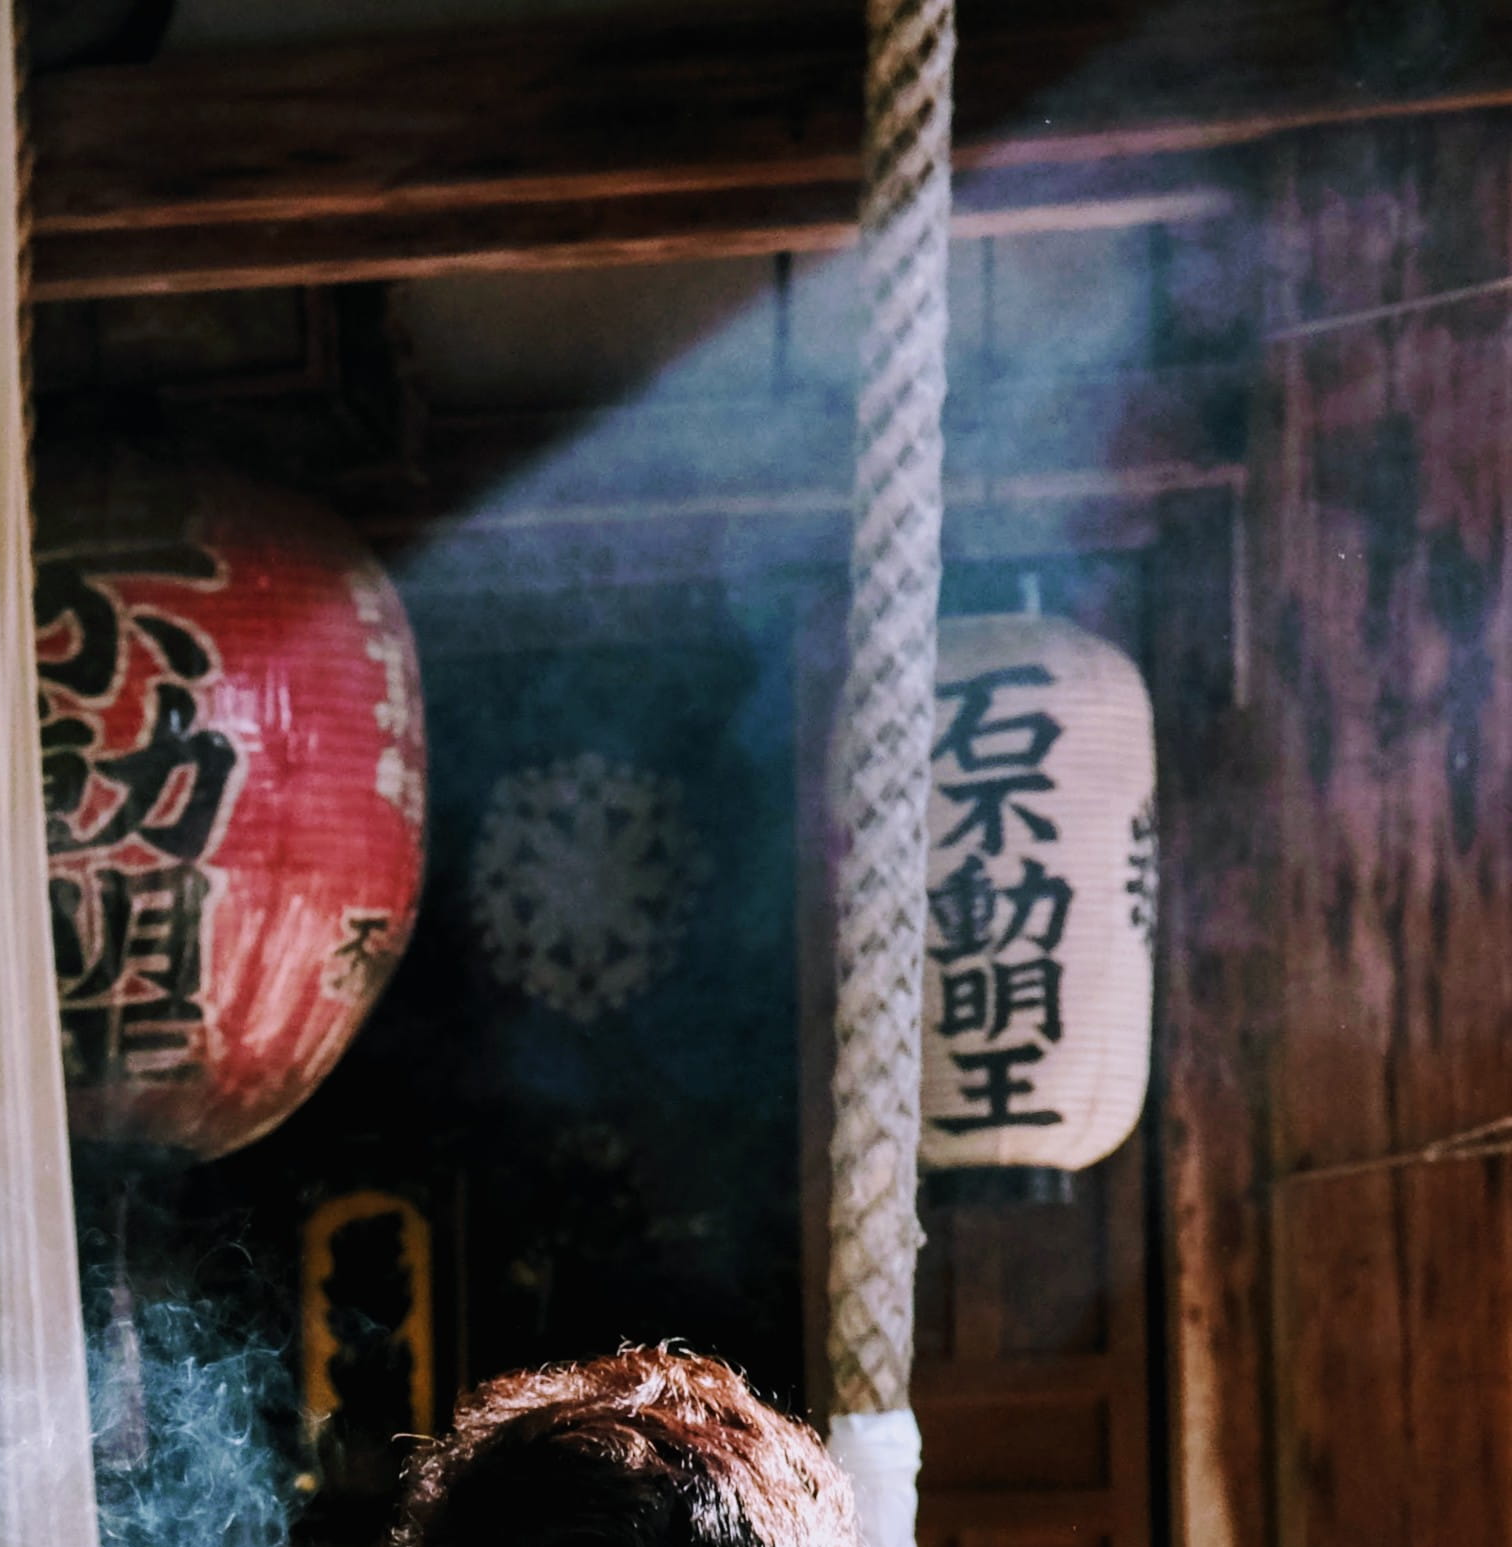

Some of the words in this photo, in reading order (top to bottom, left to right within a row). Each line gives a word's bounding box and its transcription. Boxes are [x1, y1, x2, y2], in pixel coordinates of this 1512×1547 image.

[926, 664, 1074, 1133] 石不動明王
